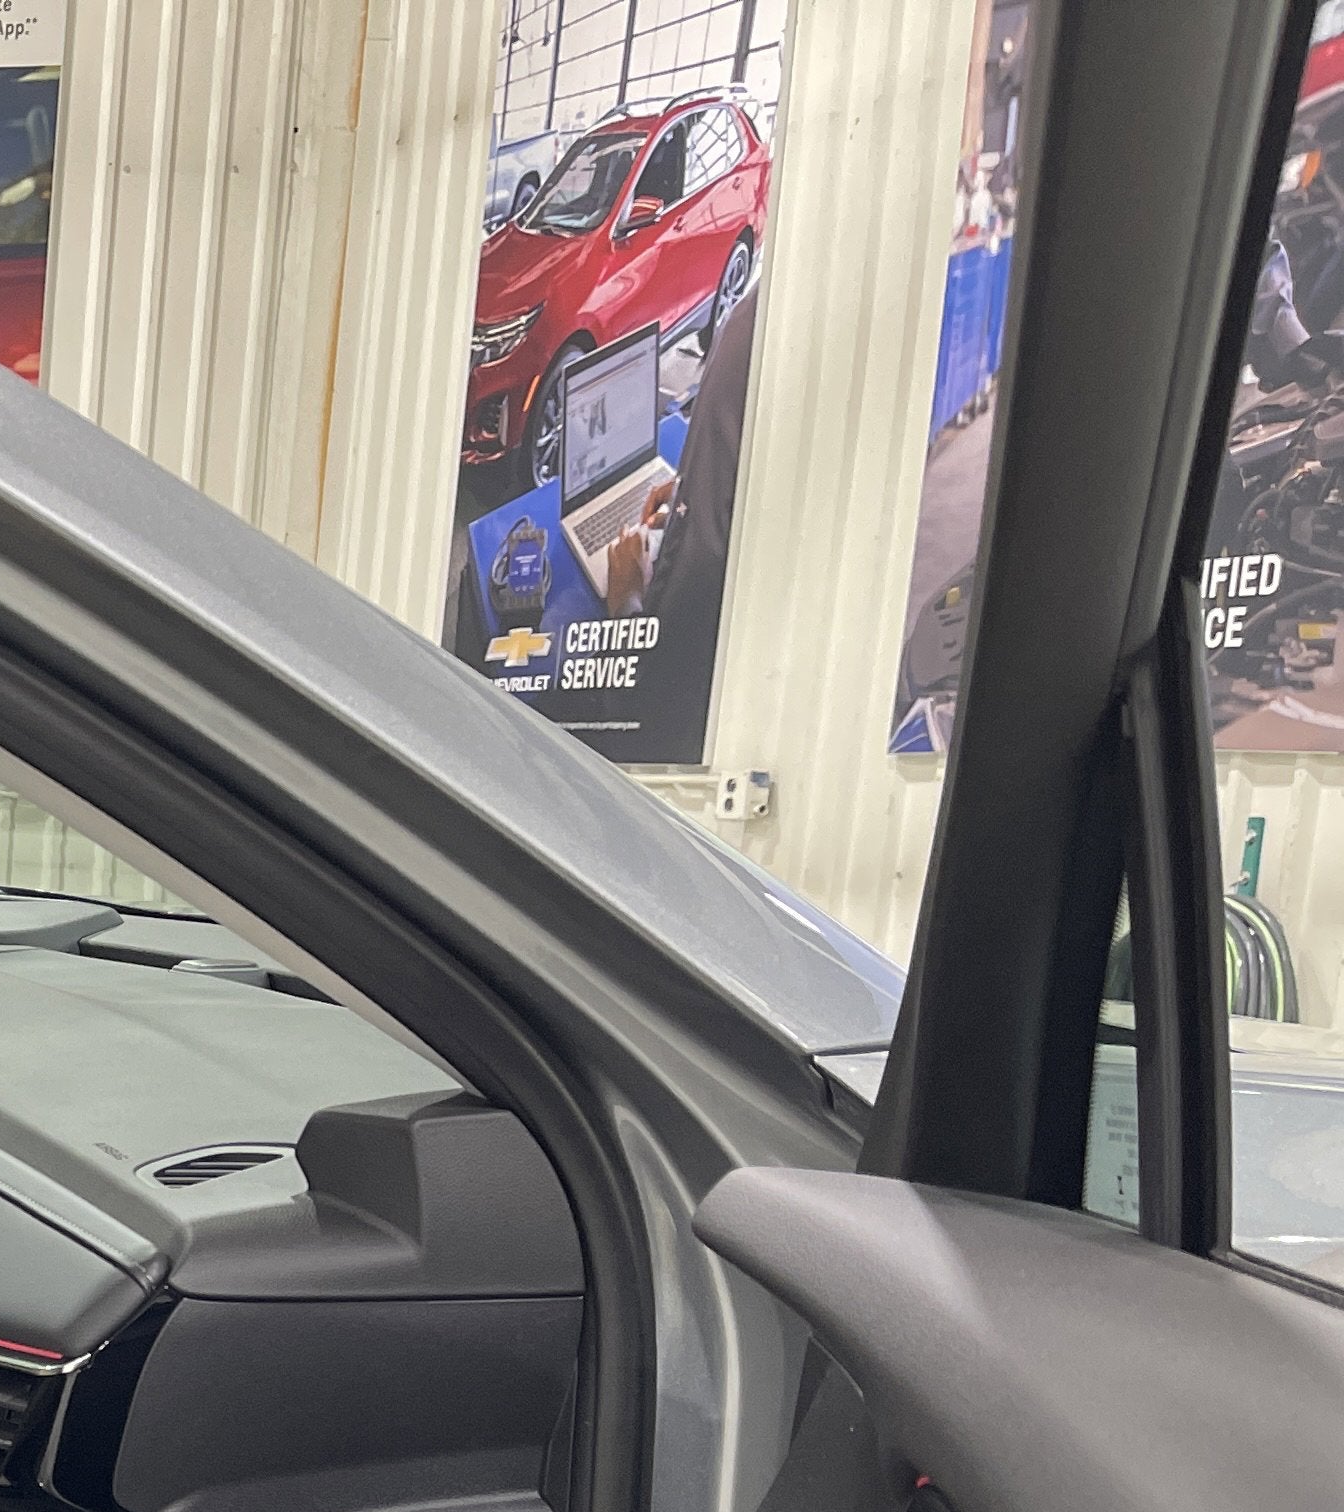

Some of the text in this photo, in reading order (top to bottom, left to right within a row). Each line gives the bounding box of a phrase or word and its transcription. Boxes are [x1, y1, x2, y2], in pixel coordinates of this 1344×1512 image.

[1200, 553, 1283, 599] IFIED
[565, 616, 660, 654] CERTIFIED
[561, 655, 640, 690] SERVICE
